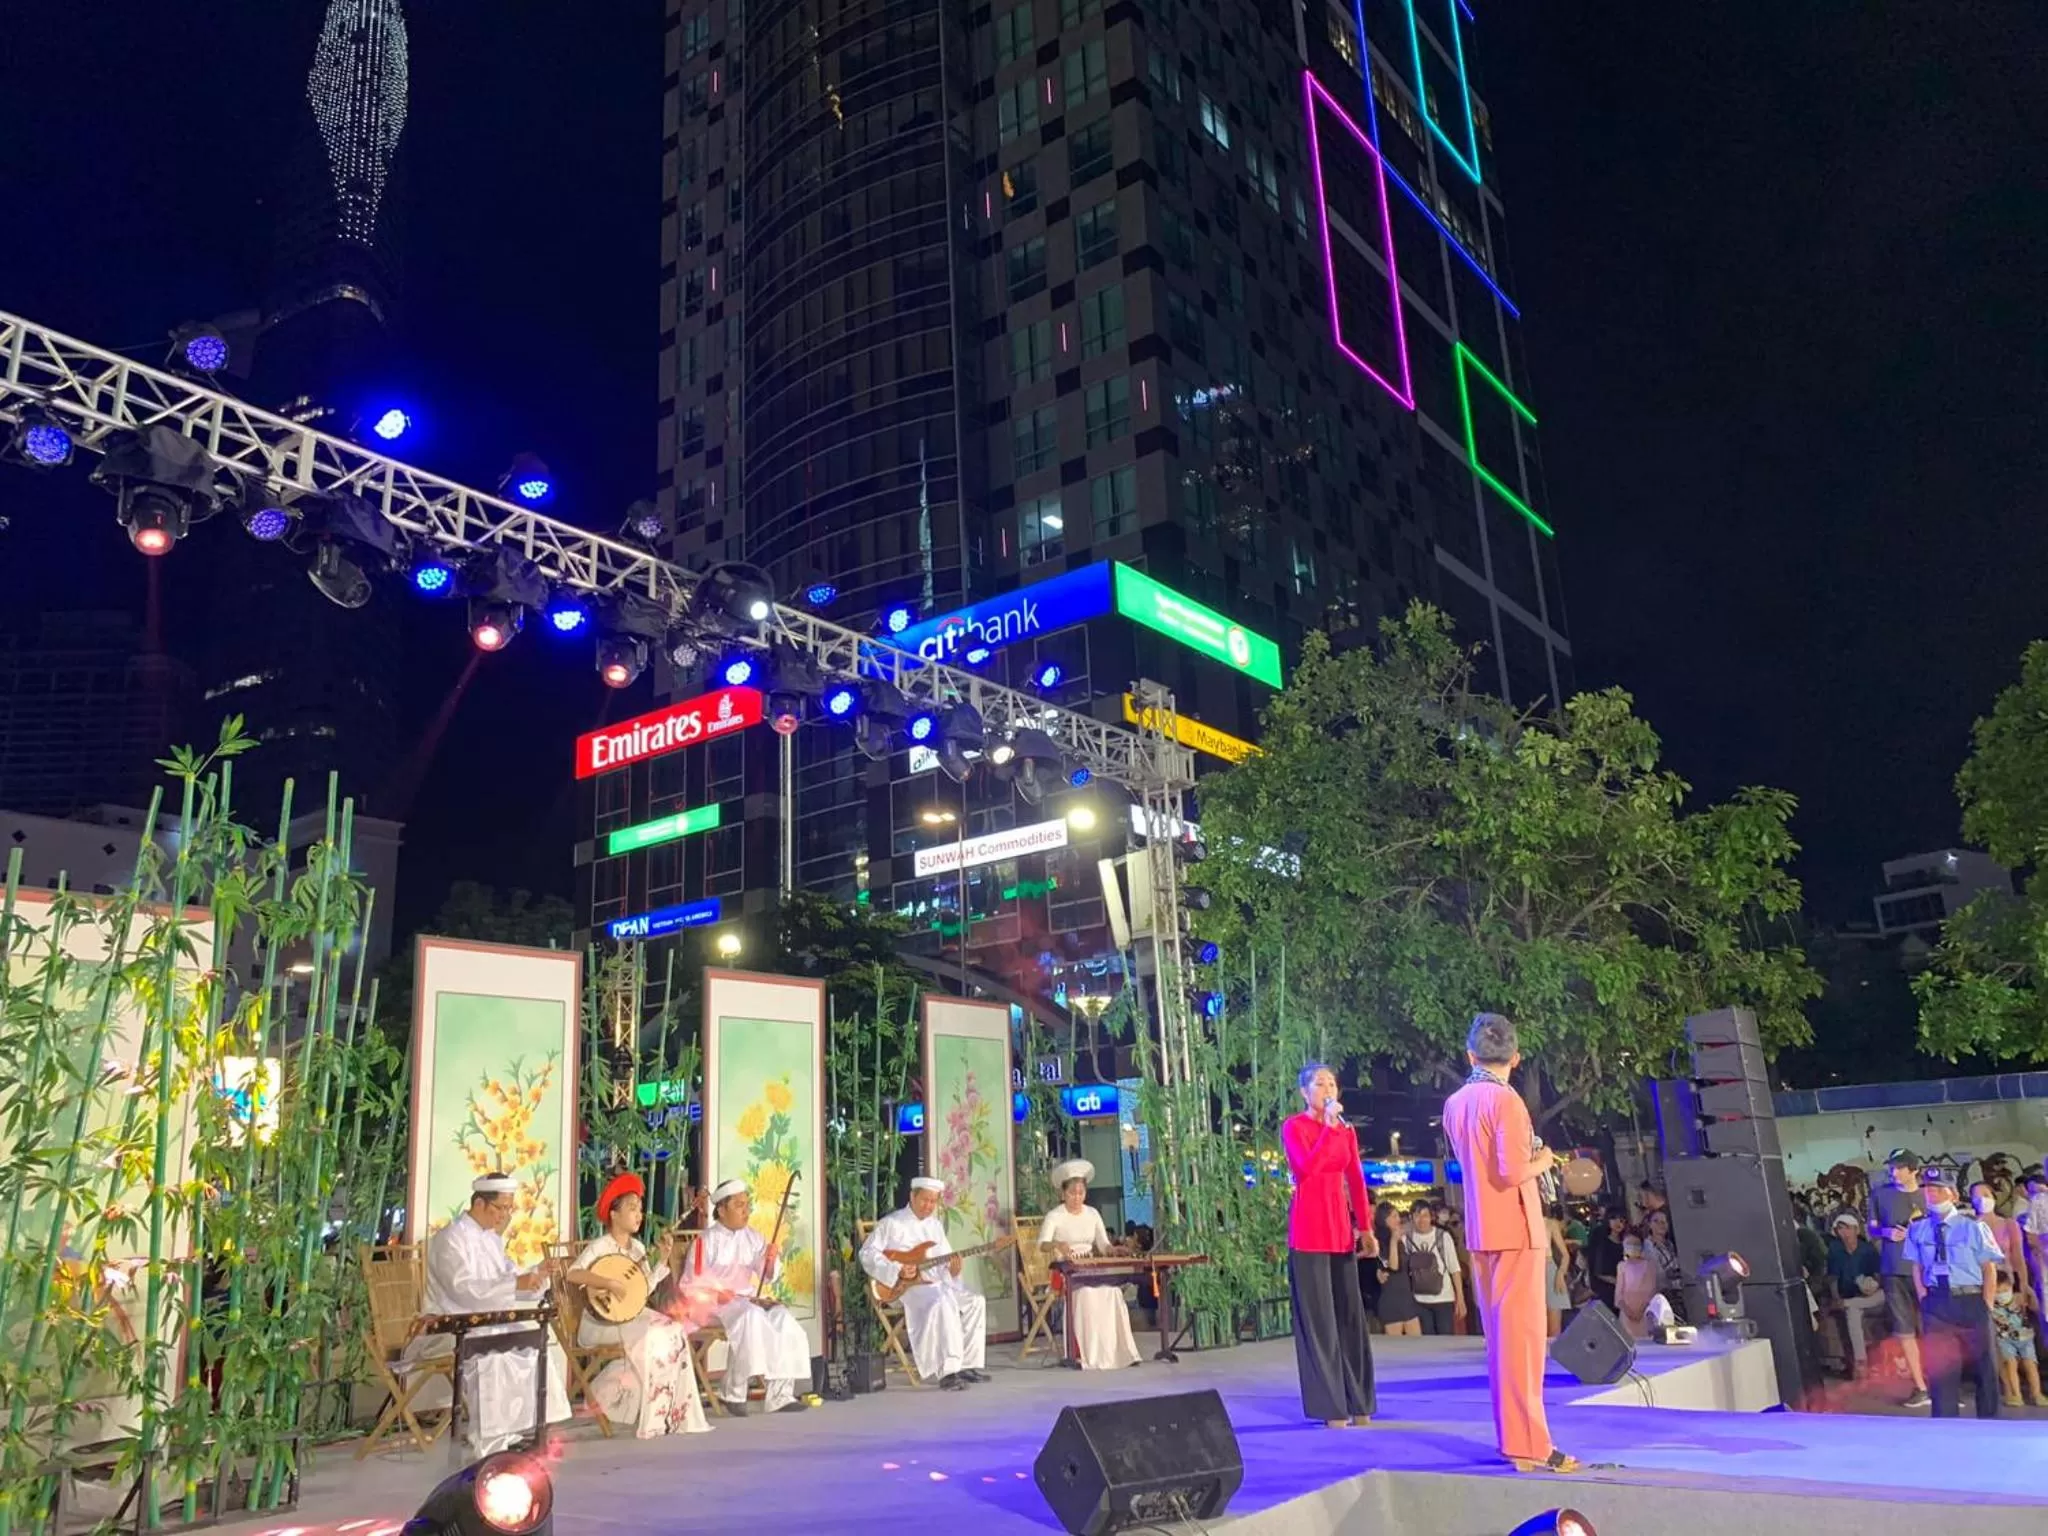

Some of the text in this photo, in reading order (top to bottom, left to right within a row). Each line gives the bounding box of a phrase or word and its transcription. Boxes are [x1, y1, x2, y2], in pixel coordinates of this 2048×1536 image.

[918, 598, 1040, 662] citbank
[592, 711, 701, 768] Emirates
[919, 829, 1063, 870] SUNWAH Commodities
